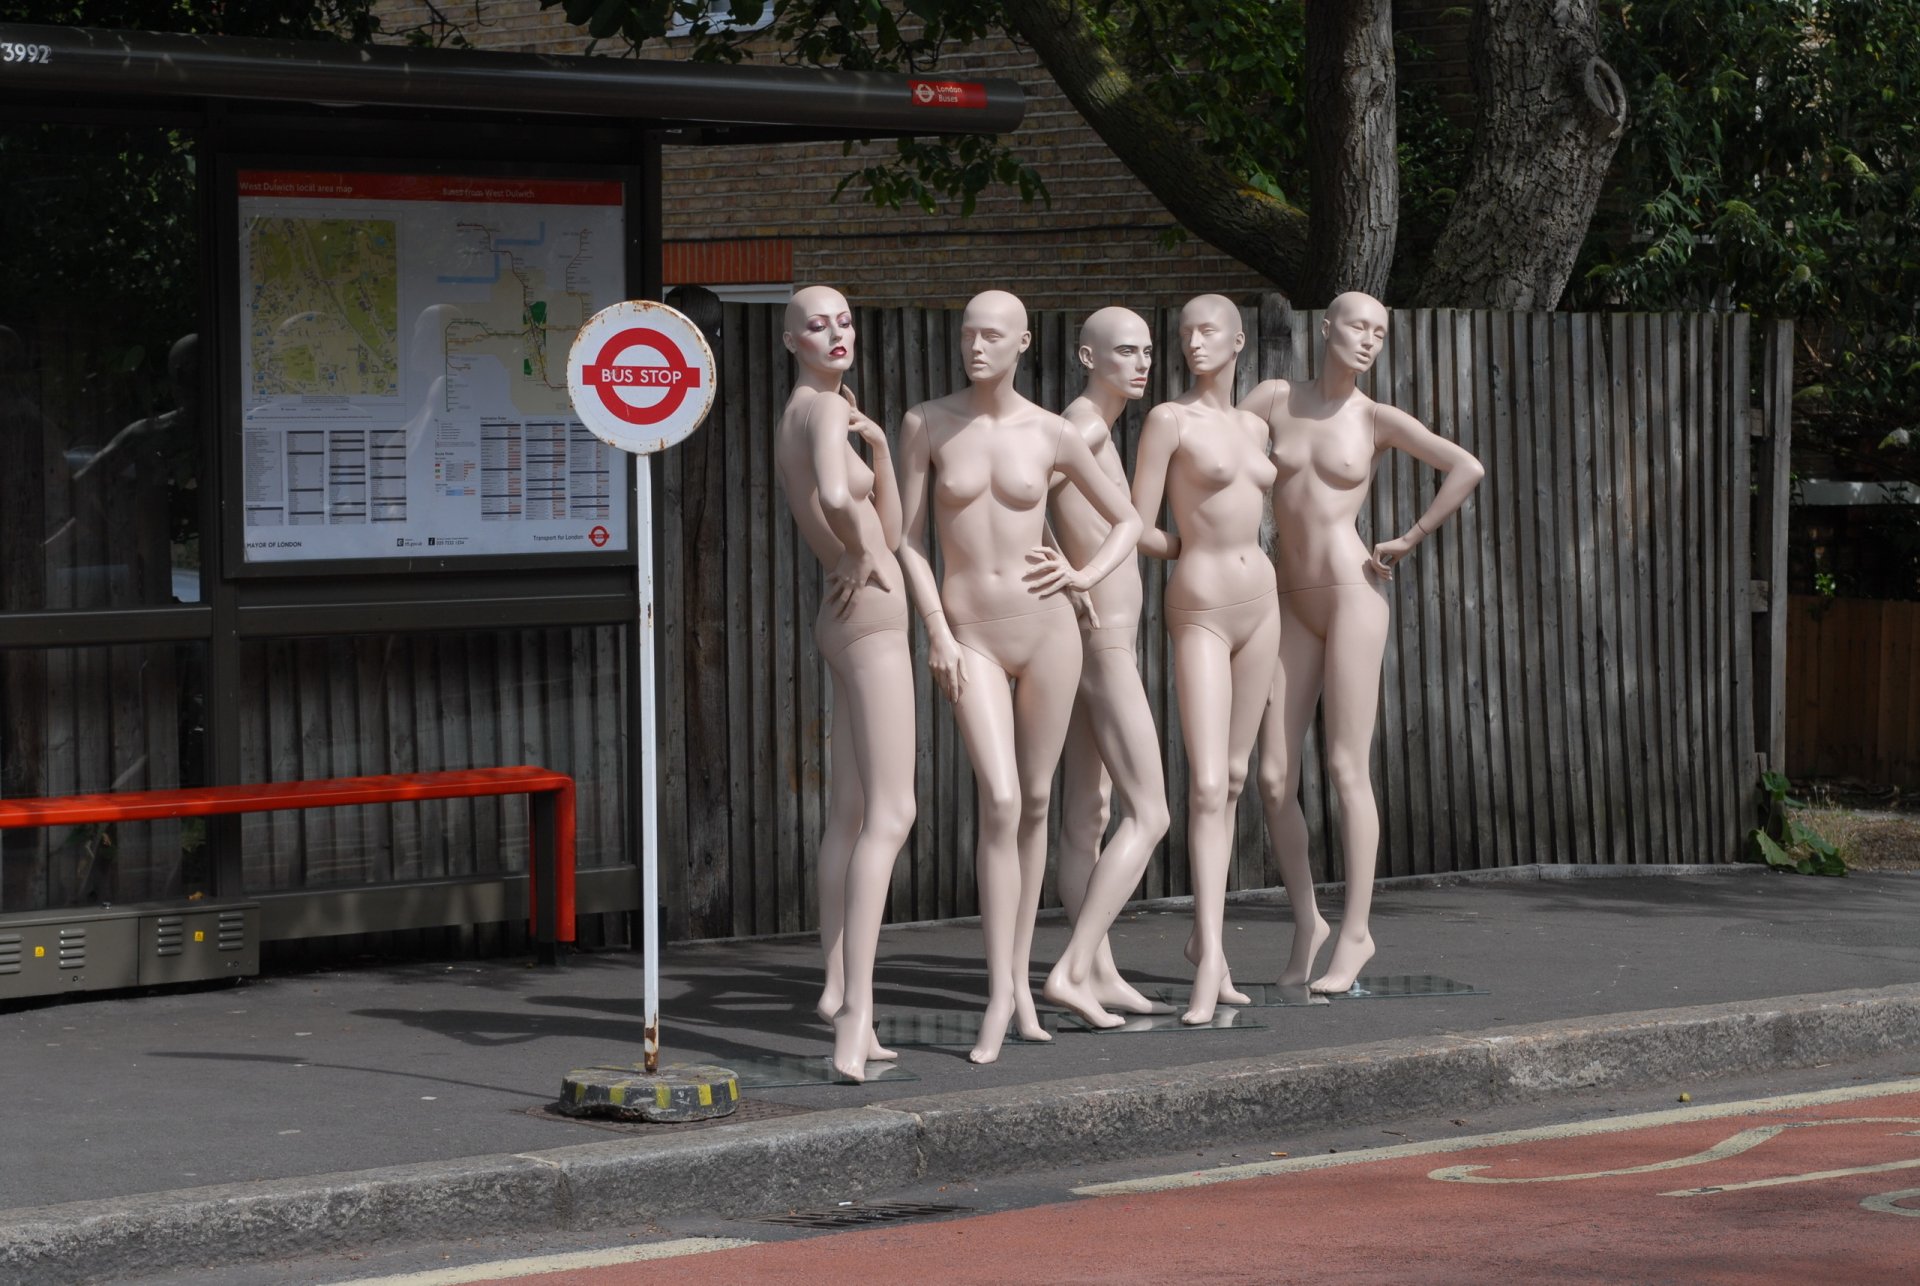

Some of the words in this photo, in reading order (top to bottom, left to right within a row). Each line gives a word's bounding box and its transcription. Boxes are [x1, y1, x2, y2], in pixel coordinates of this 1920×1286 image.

[1, 43, 49, 64] 3992
[936, 85, 963, 95] London
[938, 95, 959, 103] Buses
[240, 182, 261, 190] West
[263, 182, 295, 192] Dulwich
[296, 183, 315, 192] local
[317, 185, 334, 193] area
[336, 186, 353, 195] map
[485, 189, 504, 197] West
[505, 189, 535, 198] Dulwich
[601, 368, 634, 383] BUS
[640, 369, 682, 385] STOP
